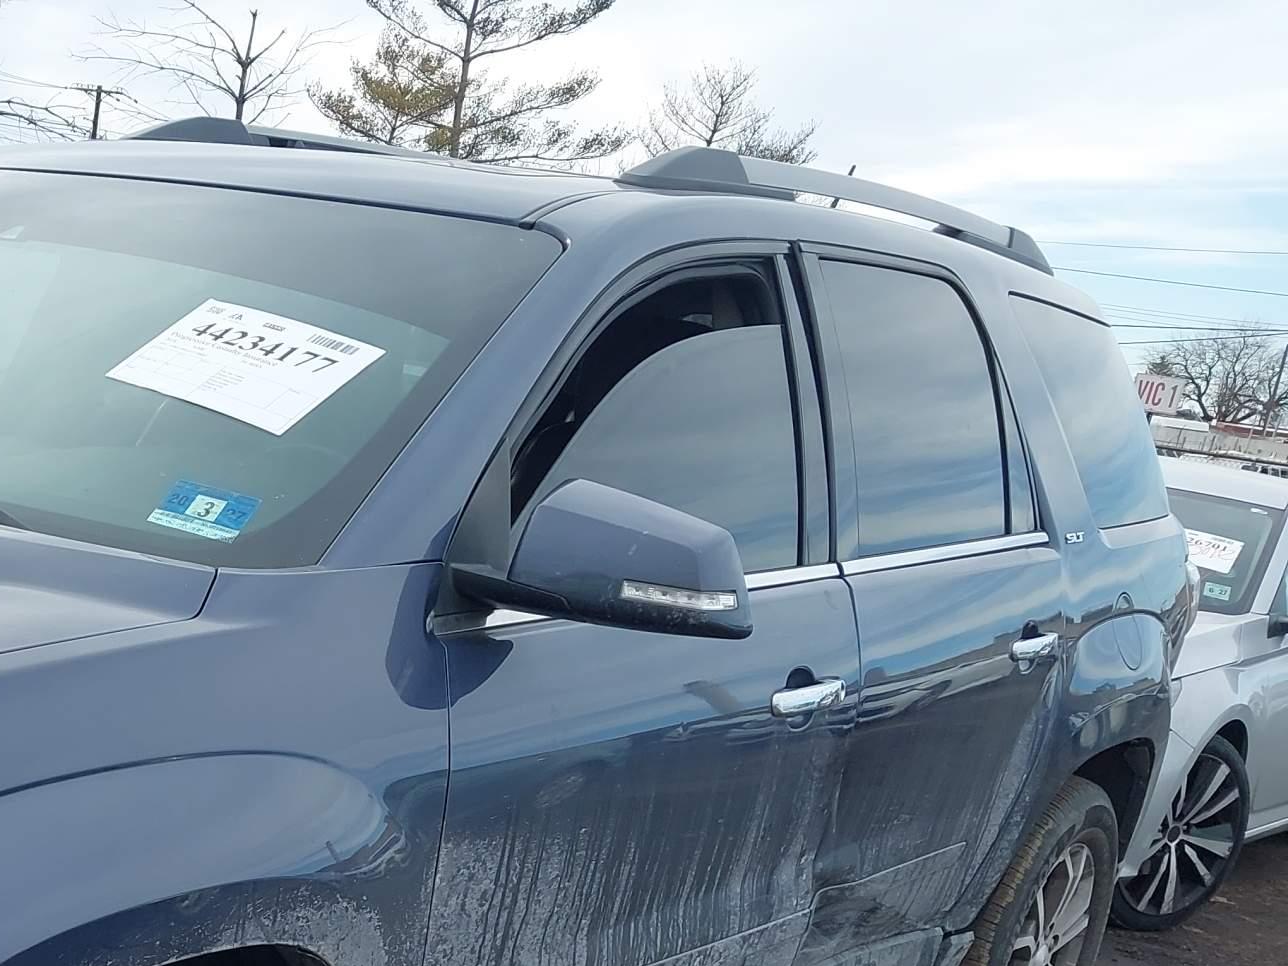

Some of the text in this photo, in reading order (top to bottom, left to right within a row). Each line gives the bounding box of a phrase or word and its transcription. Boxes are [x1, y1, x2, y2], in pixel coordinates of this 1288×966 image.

[192, 322, 339, 373] 44234177
[1137, 380, 1165, 406] VIC
[168, 493, 247, 521] 20 3 27
